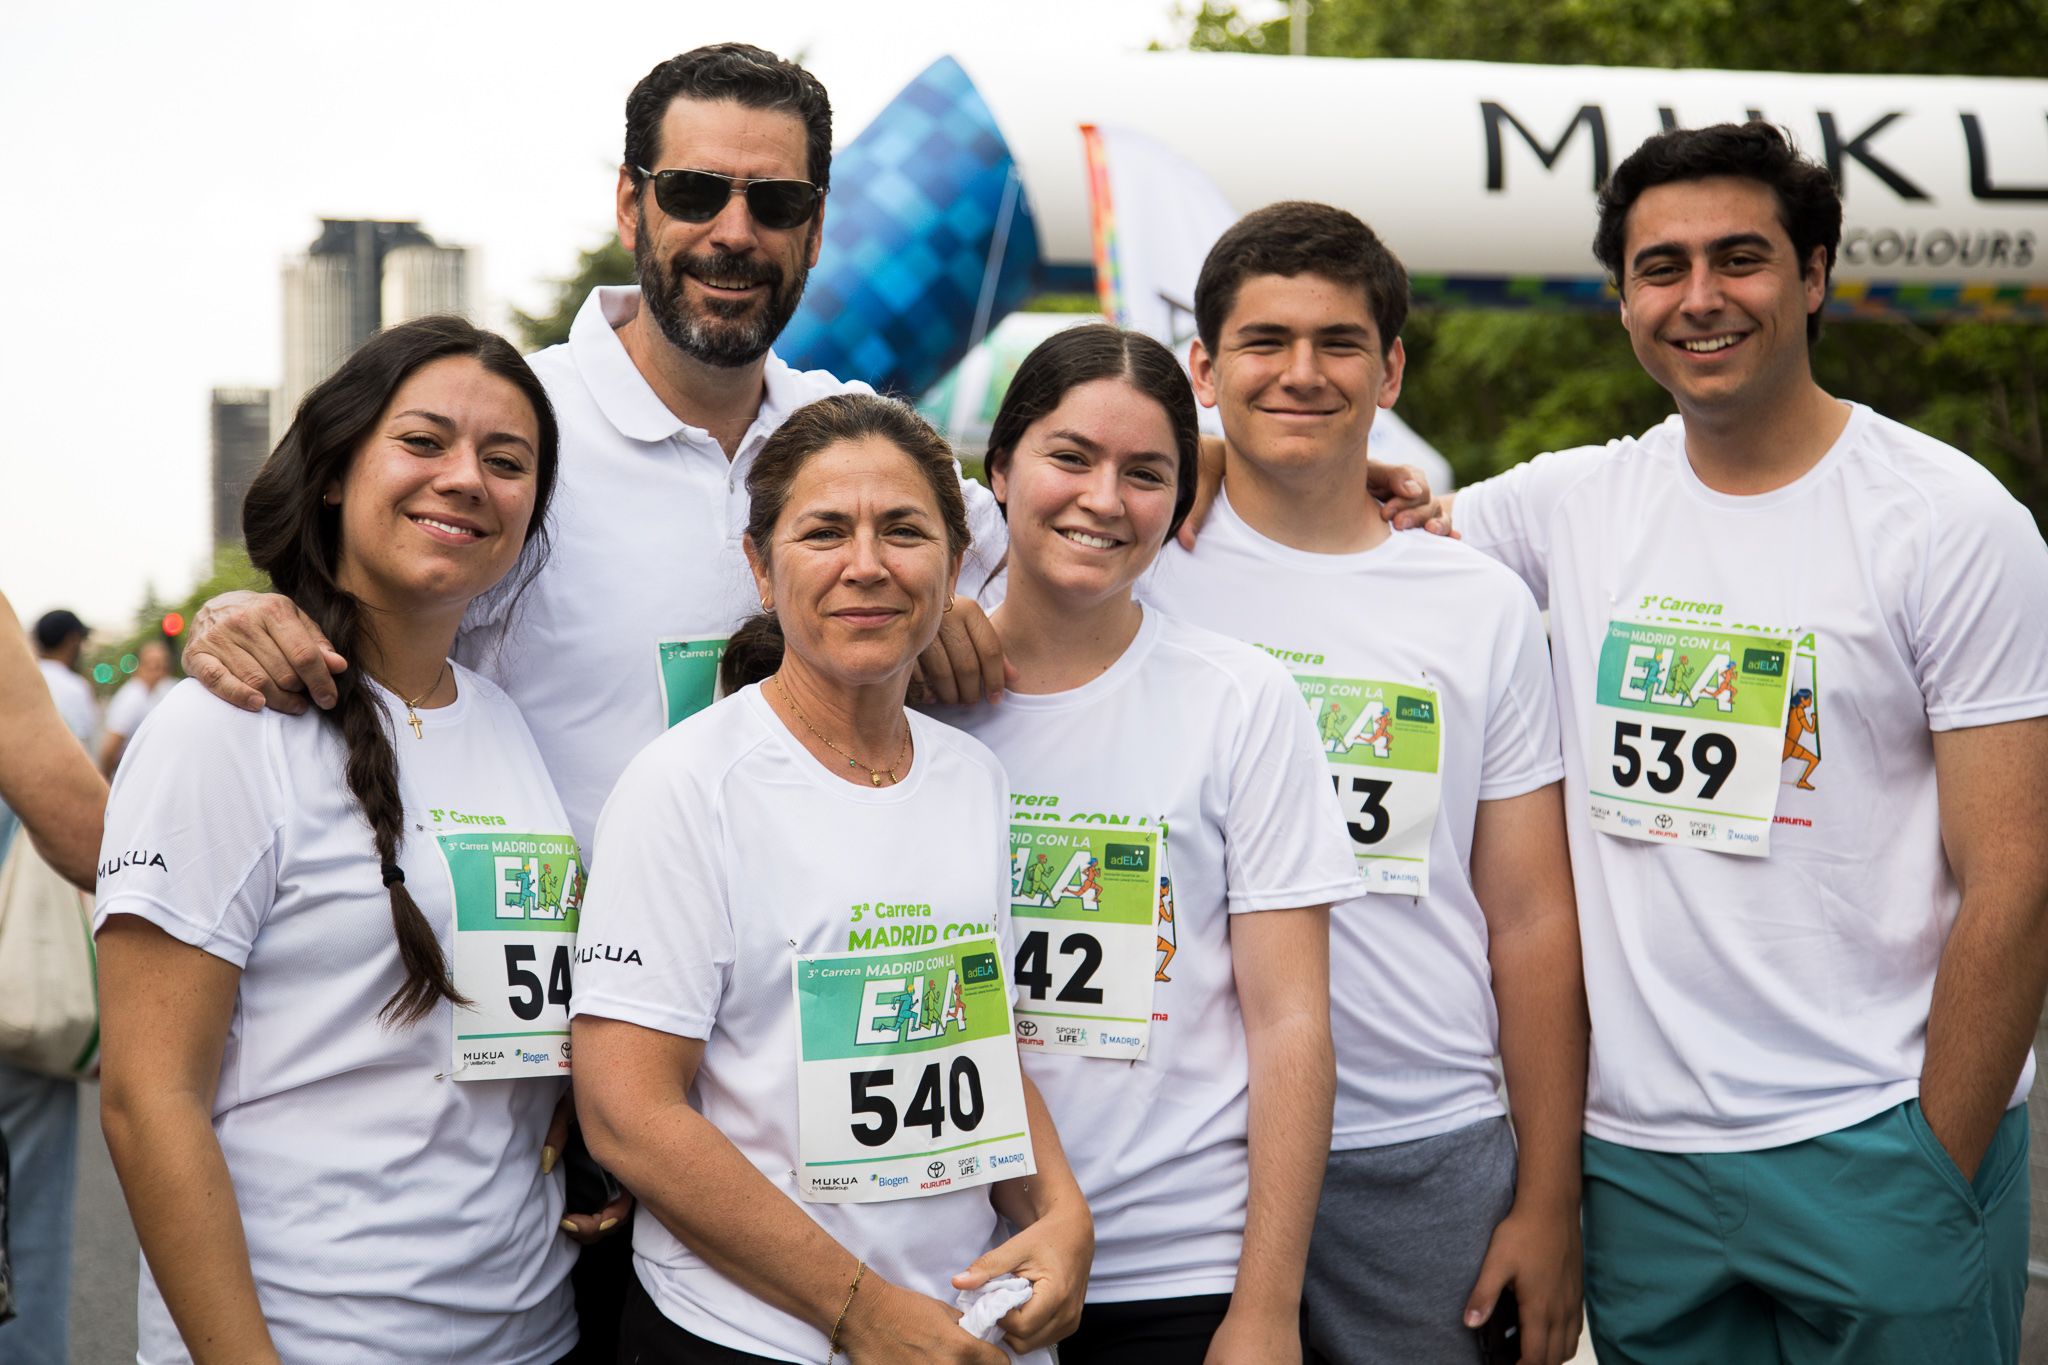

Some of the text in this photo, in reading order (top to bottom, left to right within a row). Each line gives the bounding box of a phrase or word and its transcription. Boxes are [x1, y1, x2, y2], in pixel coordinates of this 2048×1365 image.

[1845, 229, 2037, 268] COLOURS
[1660, 597, 1724, 615] Carrera
[1631, 630, 1676, 646] MADRID
[1679, 636, 1710, 650] CON
[1712, 640, 1731, 652] LA
[680, 649, 714, 659] Carrera
[1251, 643, 1325, 665] arrera
[1619, 643, 1733, 713] ELA
[1301, 682, 1383, 699] RID CON LA
[1309, 697, 1391, 759] LA
[1612, 720, 1737, 800] 539
[1010, 793, 1060, 807] rrera
[450, 810, 507, 826] Carrera
[1334, 776, 1393, 845] 3
[459, 842, 489, 851] Carrera
[491, 841, 537, 854] MADRID
[539, 843, 563, 855] CON
[565, 844, 575, 856] LA
[1010, 832, 1091, 848] RID CON LA
[1110, 854, 1143, 867] adELA
[494, 855, 581, 920] ELA
[1011, 847, 1100, 912] LA
[851, 902, 931, 922] 3ª Carrera
[848, 924, 938, 952] MADRID
[821, 968, 861, 978] Carrera
[865, 960, 924, 977] MADRID
[926, 956, 945, 970] CON
[945, 953, 955, 967] LA
[1014, 930, 1104, 1005] 42
[503, 944, 573, 1021] 54
[854, 969, 967, 1046] ELA
[1055, 1027, 1081, 1035] SPORT
[1058, 1034, 1077, 1043] LIFE
[1109, 1036, 1140, 1046] MADRID
[463, 1051, 505, 1061] MUKUA
[522, 1052, 549, 1064] Biogen
[849, 1055, 985, 1147] 540
[958, 1156, 975, 1168] SPORT
[997, 1153, 1025, 1166] MADRID
[961, 1165, 974, 1176] LIFE
[812, 1176, 858, 1186] MUKUA
[879, 1176, 909, 1187] Biogen
